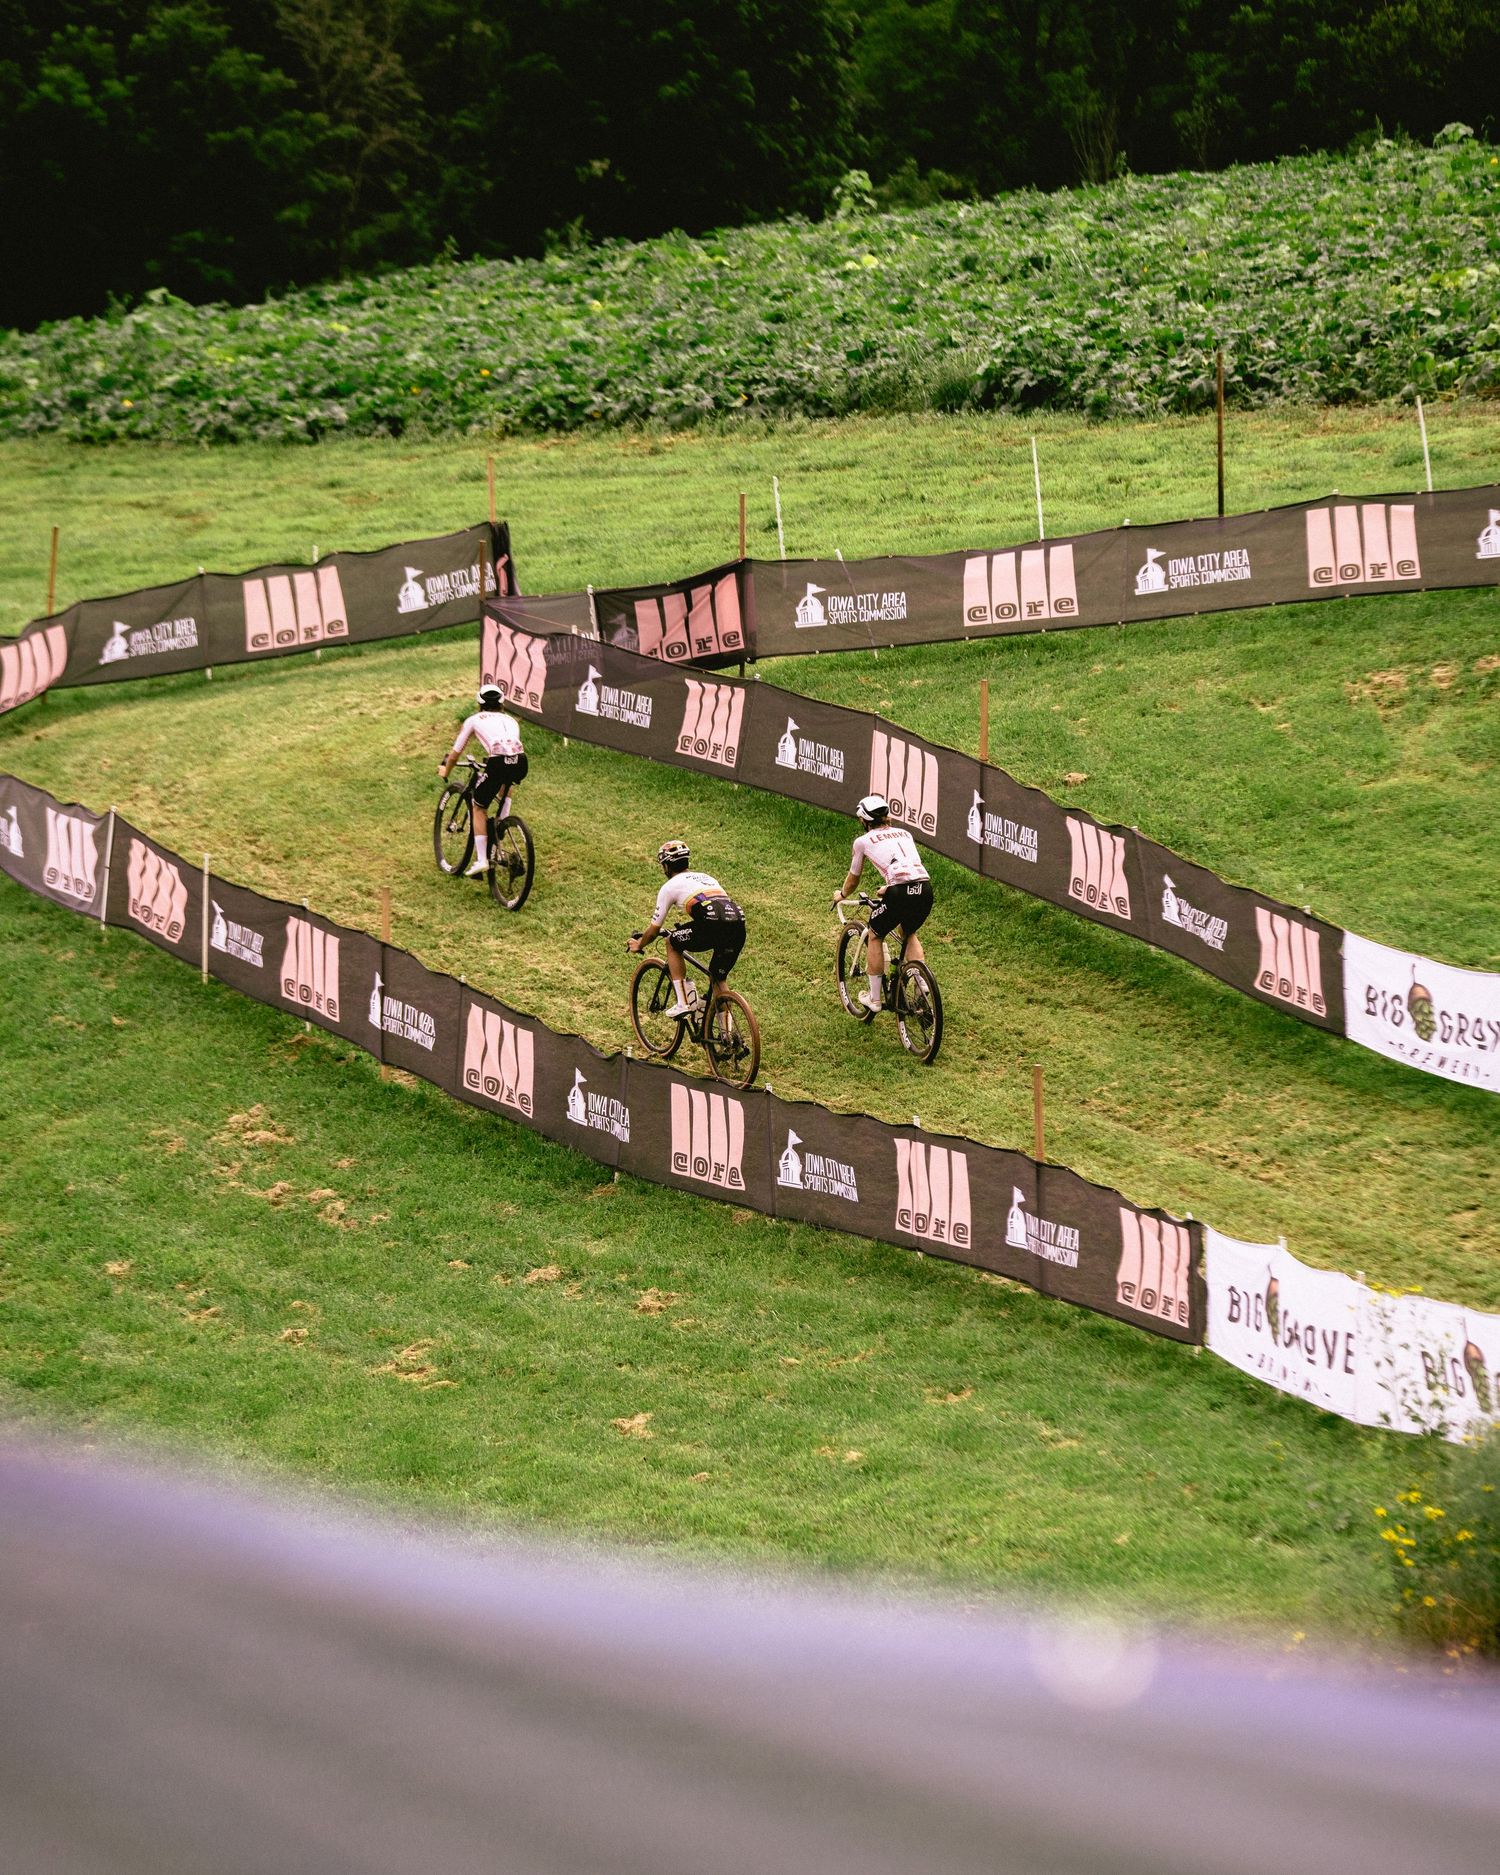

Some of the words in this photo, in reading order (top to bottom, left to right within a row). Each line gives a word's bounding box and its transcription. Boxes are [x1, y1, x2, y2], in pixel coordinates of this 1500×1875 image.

[1168, 556, 1195, 576] IOWA
[1197, 552, 1220, 571] CITY
[1223, 548, 1249, 568] AREA
[1313, 559, 1417, 583] core
[425, 573, 451, 594] IOWA
[450, 568, 470, 588] CITY
[1170, 572, 1200, 589] SPORTS
[1201, 566, 1251, 584] COMMISSION
[428, 589, 455, 606] SPORTS
[828, 595, 854, 611] IOWA
[857, 592, 879, 611] CITY
[882, 591, 906, 608] AREA
[967, 597, 1075, 622] core
[152, 621, 173, 641] CITY
[173, 617, 198, 637] AREA
[829, 610, 857, 625] SPORTS
[859, 606, 907, 622] COMMISSION
[251, 619, 344, 648] core
[648, 630, 741, 659] ore
[600, 685, 619, 706] IOWA
[619, 690, 636, 710] CITY
[635, 694, 652, 715] AREA
[599, 703, 620, 720] SPORTS
[619, 708, 651, 729] COMMISSION
[680, 734, 736, 763] core
[798, 737, 815, 759] IOWA
[815, 743, 829, 763] CITY
[829, 747, 845, 769] AREA
[797, 755, 816, 774] SPORTS
[871, 792, 935, 832] ore
[985, 812, 1003, 835] IOWA
[1004, 819, 1019, 841] CITY
[1019, 825, 1038, 848] AREA
[984, 830, 1005, 851] SPORTS
[1005, 838, 1038, 863] COMMISSION
[1072, 877, 1129, 916] core
[132, 898, 181, 938] core
[284, 978, 337, 1017] core
[1259, 970, 1325, 1013] core
[1365, 984, 1404, 1027] BIG
[383, 995, 403, 1021] IOWA
[404, 1004, 419, 1027] CITY
[381, 1015, 404, 1037] SPORTS
[466, 1068, 531, 1114] core
[587, 1091, 608, 1116] IOWA
[588, 1112, 610, 1132] SPORTS
[674, 1152, 742, 1187] core
[805, 1152, 825, 1176] IOWA
[804, 1173, 828, 1193] SPORTS
[898, 1208, 968, 1244] core
[1040, 1219, 1057, 1244] CITY
[1056, 1224, 1080, 1251] AREA
[1120, 1281, 1188, 1323] core
[1228, 1285, 1264, 1332] BIG
